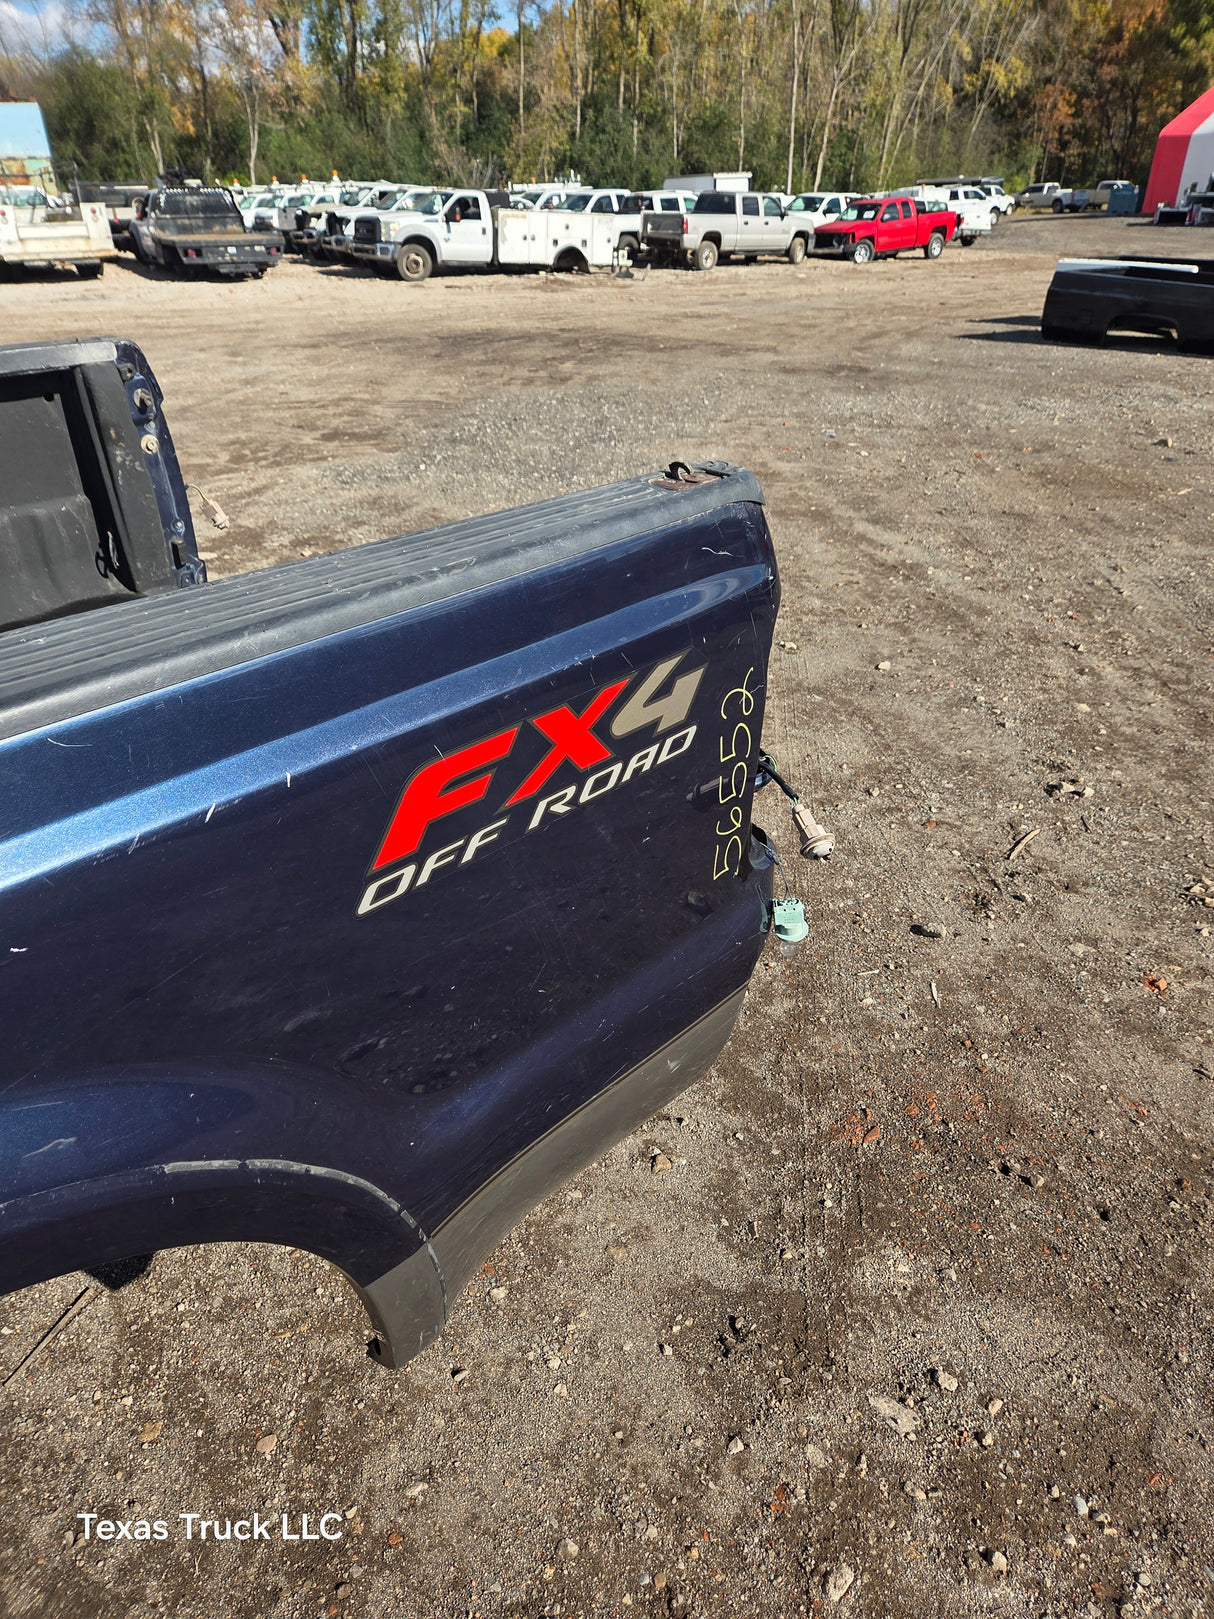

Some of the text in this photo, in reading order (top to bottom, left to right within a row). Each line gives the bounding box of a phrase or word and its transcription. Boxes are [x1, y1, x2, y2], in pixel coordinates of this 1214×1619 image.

[356, 724, 699, 917] OFF ROAD
[370, 650, 706, 873] FX4
[713, 666, 754, 881] 56552
